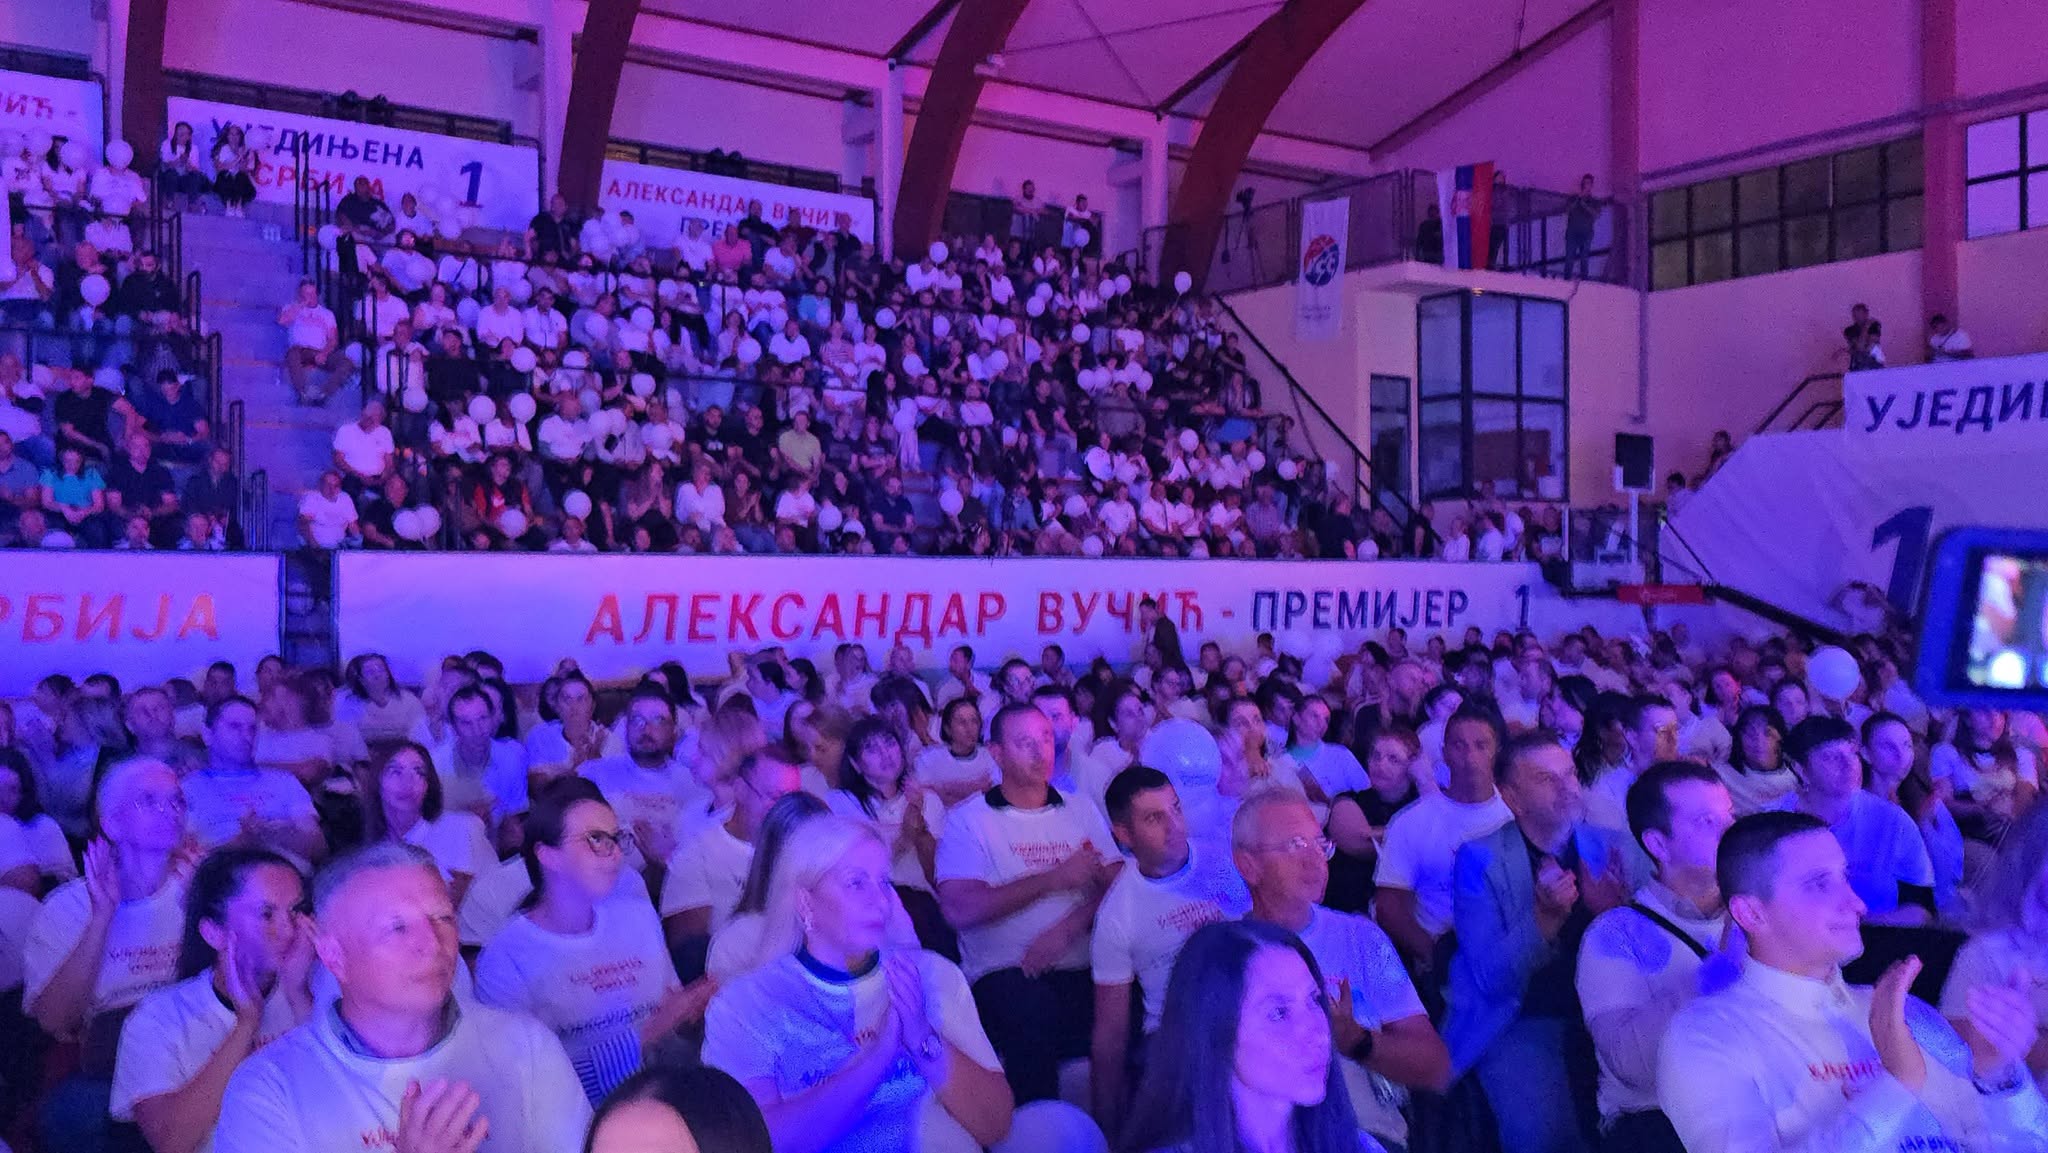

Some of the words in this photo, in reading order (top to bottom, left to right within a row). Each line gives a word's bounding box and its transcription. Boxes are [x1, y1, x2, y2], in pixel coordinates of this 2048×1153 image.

[0, 92, 53, 119] ИЋ
[210, 118, 424, 170] УДИЊЕНА
[459, 159, 484, 209] 1
[255, 160, 385, 201] СРБИА
[606, 178, 755, 216] АЛЕКСАНДА
[584, 591, 1007, 649] АЛЕКСАНДАР
[1252, 588, 1469, 631] ПРЕМИЈЕР
[1514, 584, 1532, 632] 1
